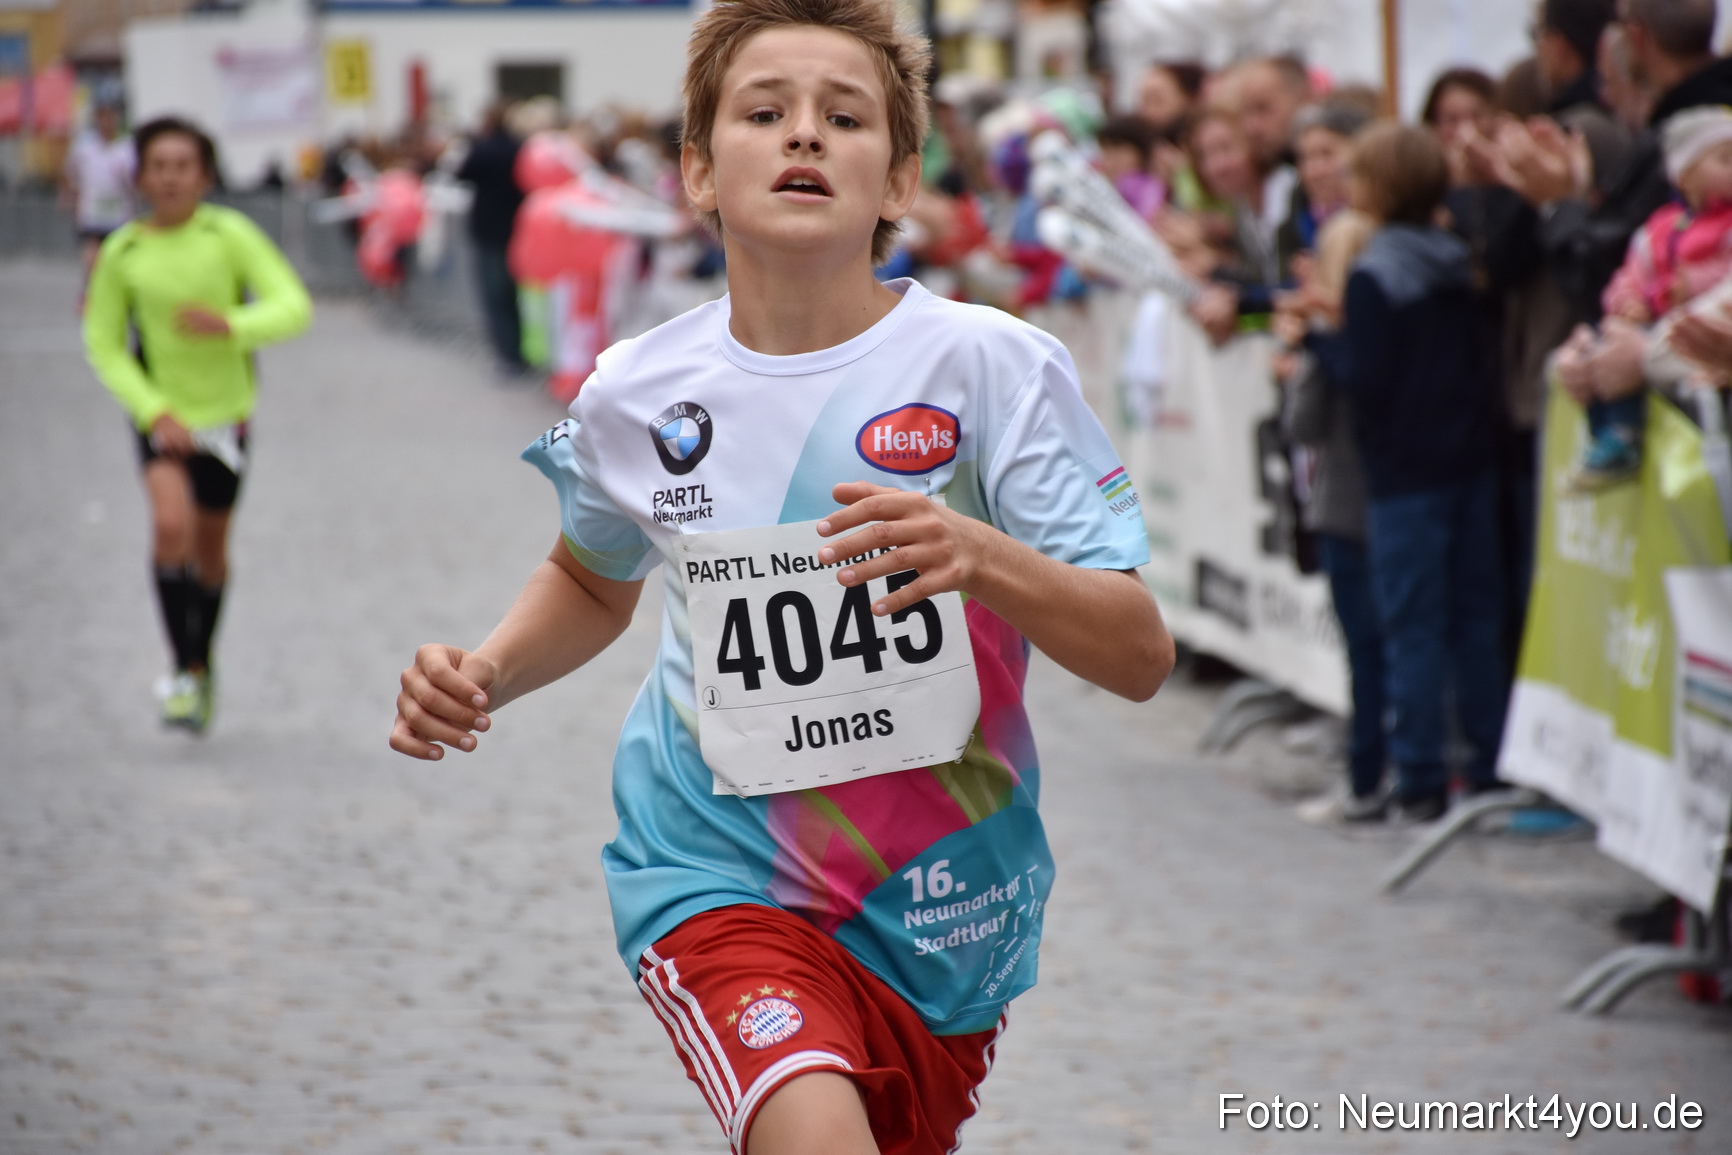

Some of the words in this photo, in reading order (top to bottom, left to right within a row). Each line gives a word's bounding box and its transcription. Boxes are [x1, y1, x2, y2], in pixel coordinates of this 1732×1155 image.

[651, 403, 709, 429] BMW
[873, 424, 954, 456] Hervis
[879, 452, 920, 461] SPORTS
[653, 484, 713, 509] PARTL
[653, 505, 713, 524] Neumarkt
[686, 557, 765, 584] PARTL
[717, 568, 943, 691] 4045
[708, 689, 716, 706] J
[785, 708, 894, 753] Jonas
[902, 859, 966, 903] 16.
[914, 909, 1010, 956] Stadtlauf
[985, 982, 1000, 998] 20.
